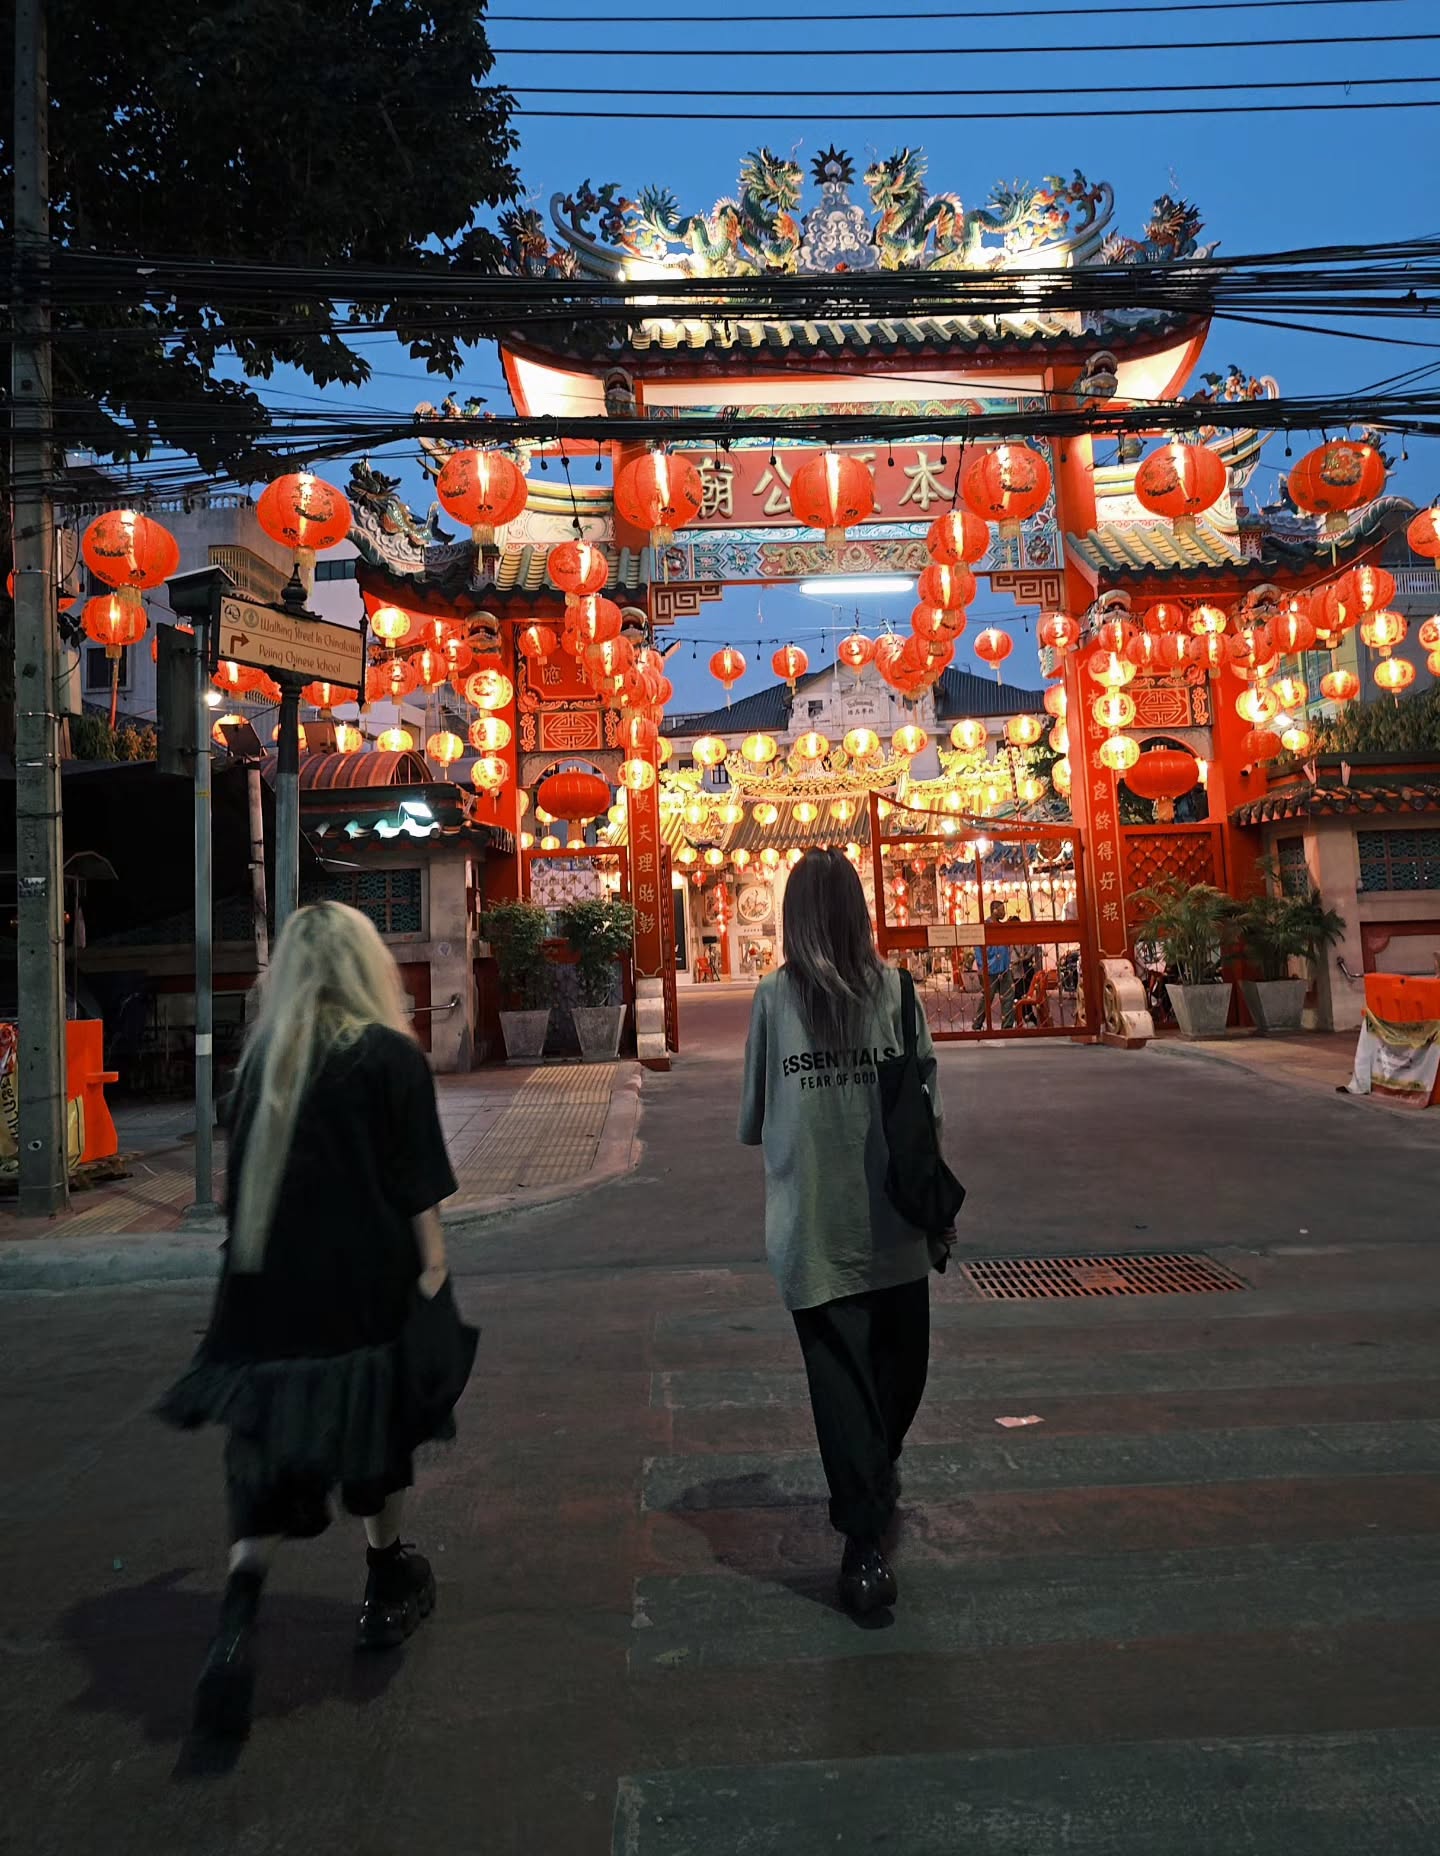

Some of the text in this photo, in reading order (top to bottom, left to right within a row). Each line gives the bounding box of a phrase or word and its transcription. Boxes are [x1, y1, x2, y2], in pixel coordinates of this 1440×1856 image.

[295, 625, 314, 642] Street
[324, 635, 361, 653] Chinatown
[285, 650, 314, 667] Chinese
[316, 659, 341, 673] School
[800, 1071, 876, 1090] FEAR OF GOD
